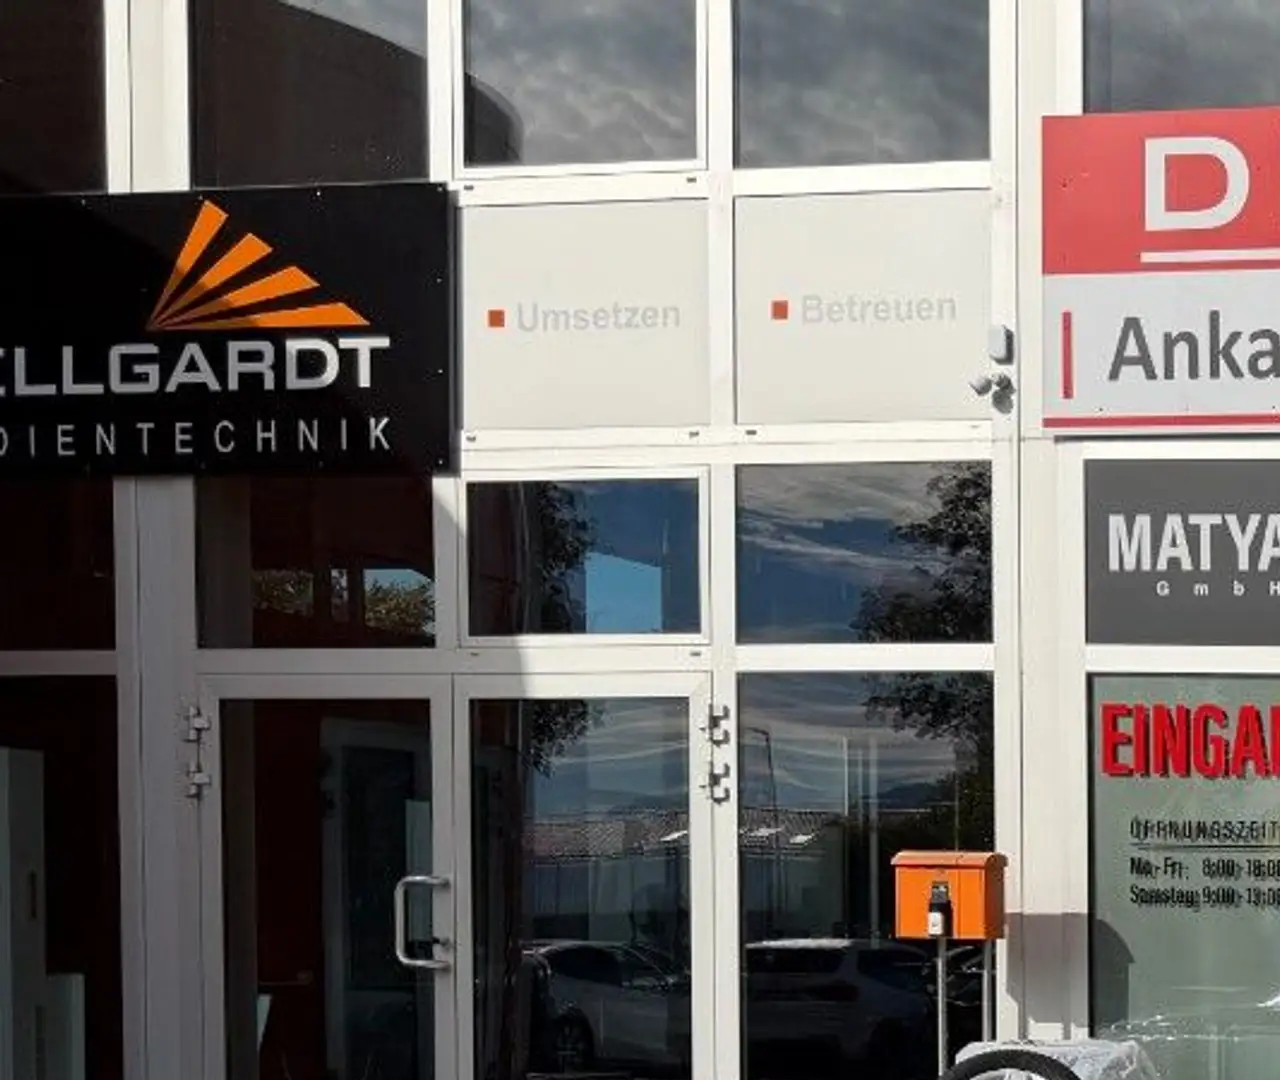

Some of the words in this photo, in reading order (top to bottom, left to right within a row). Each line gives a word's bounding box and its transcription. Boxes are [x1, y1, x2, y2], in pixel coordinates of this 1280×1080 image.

[517, 301, 681, 333] Umsetzen
[801, 293, 957, 325] Betreuen
[0, 336, 390, 396] LLGARDT
